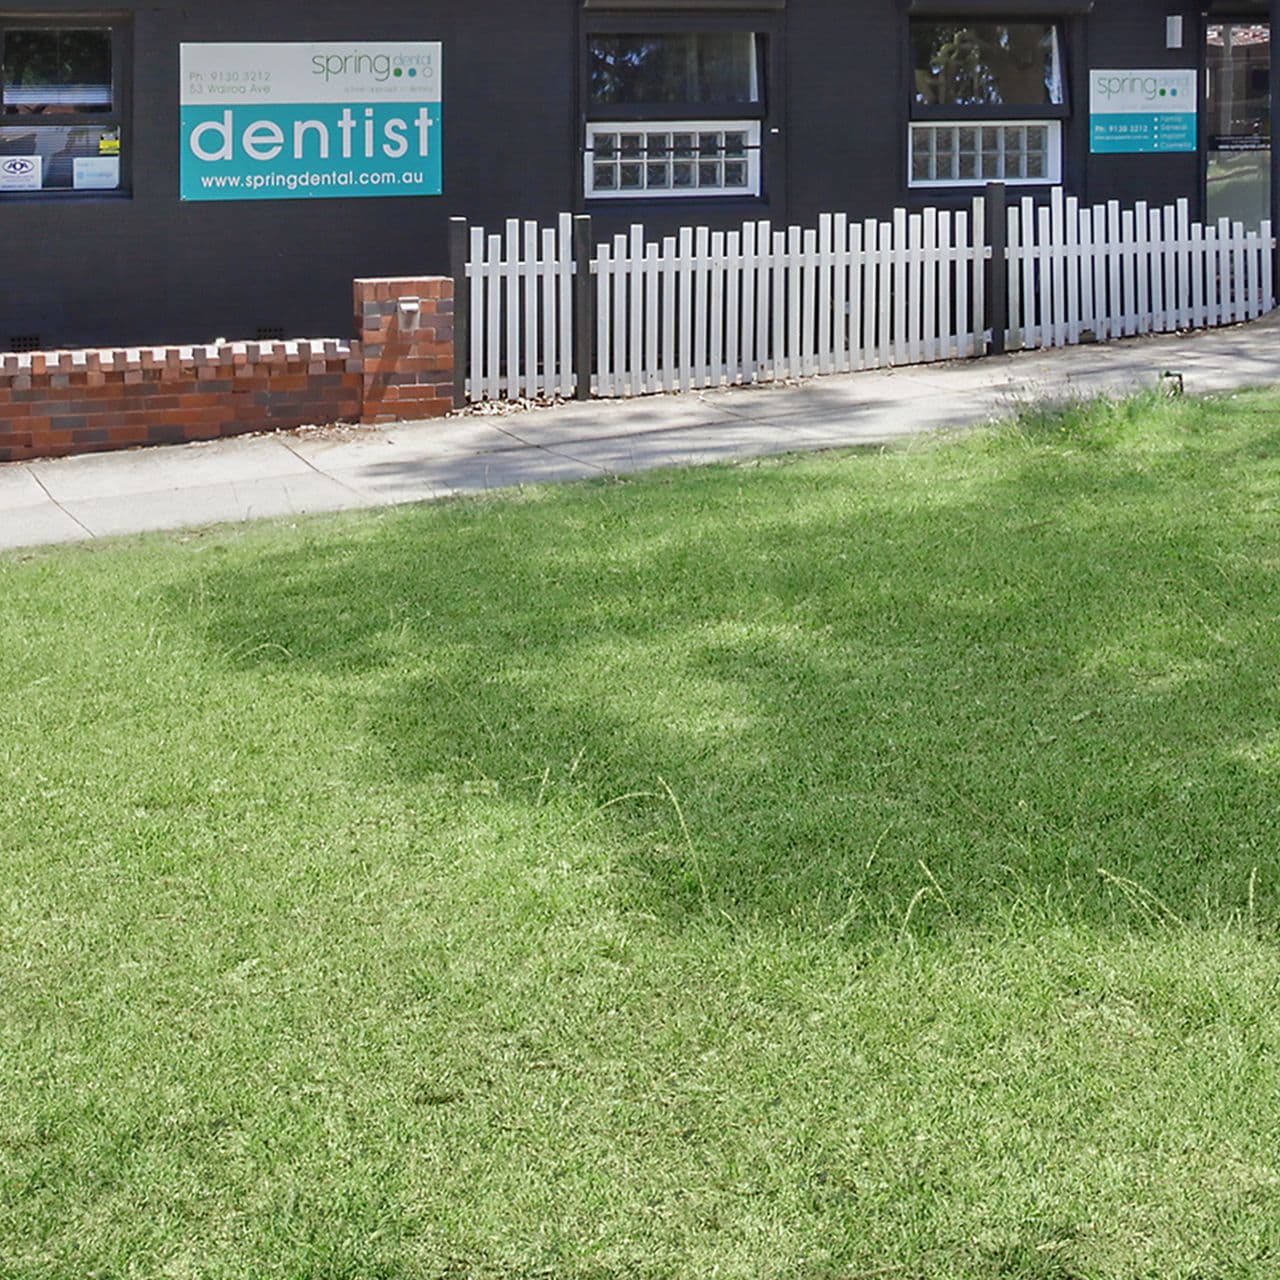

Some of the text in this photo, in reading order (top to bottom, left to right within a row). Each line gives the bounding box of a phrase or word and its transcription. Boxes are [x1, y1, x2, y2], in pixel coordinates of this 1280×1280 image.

[311, 49, 432, 83] spring dental
[249, 83, 271, 94] Ave
[1096, 71, 1158, 101] spring
[189, 107, 434, 161] dentist
[200, 170, 424, 190] www.springdental.com.au
